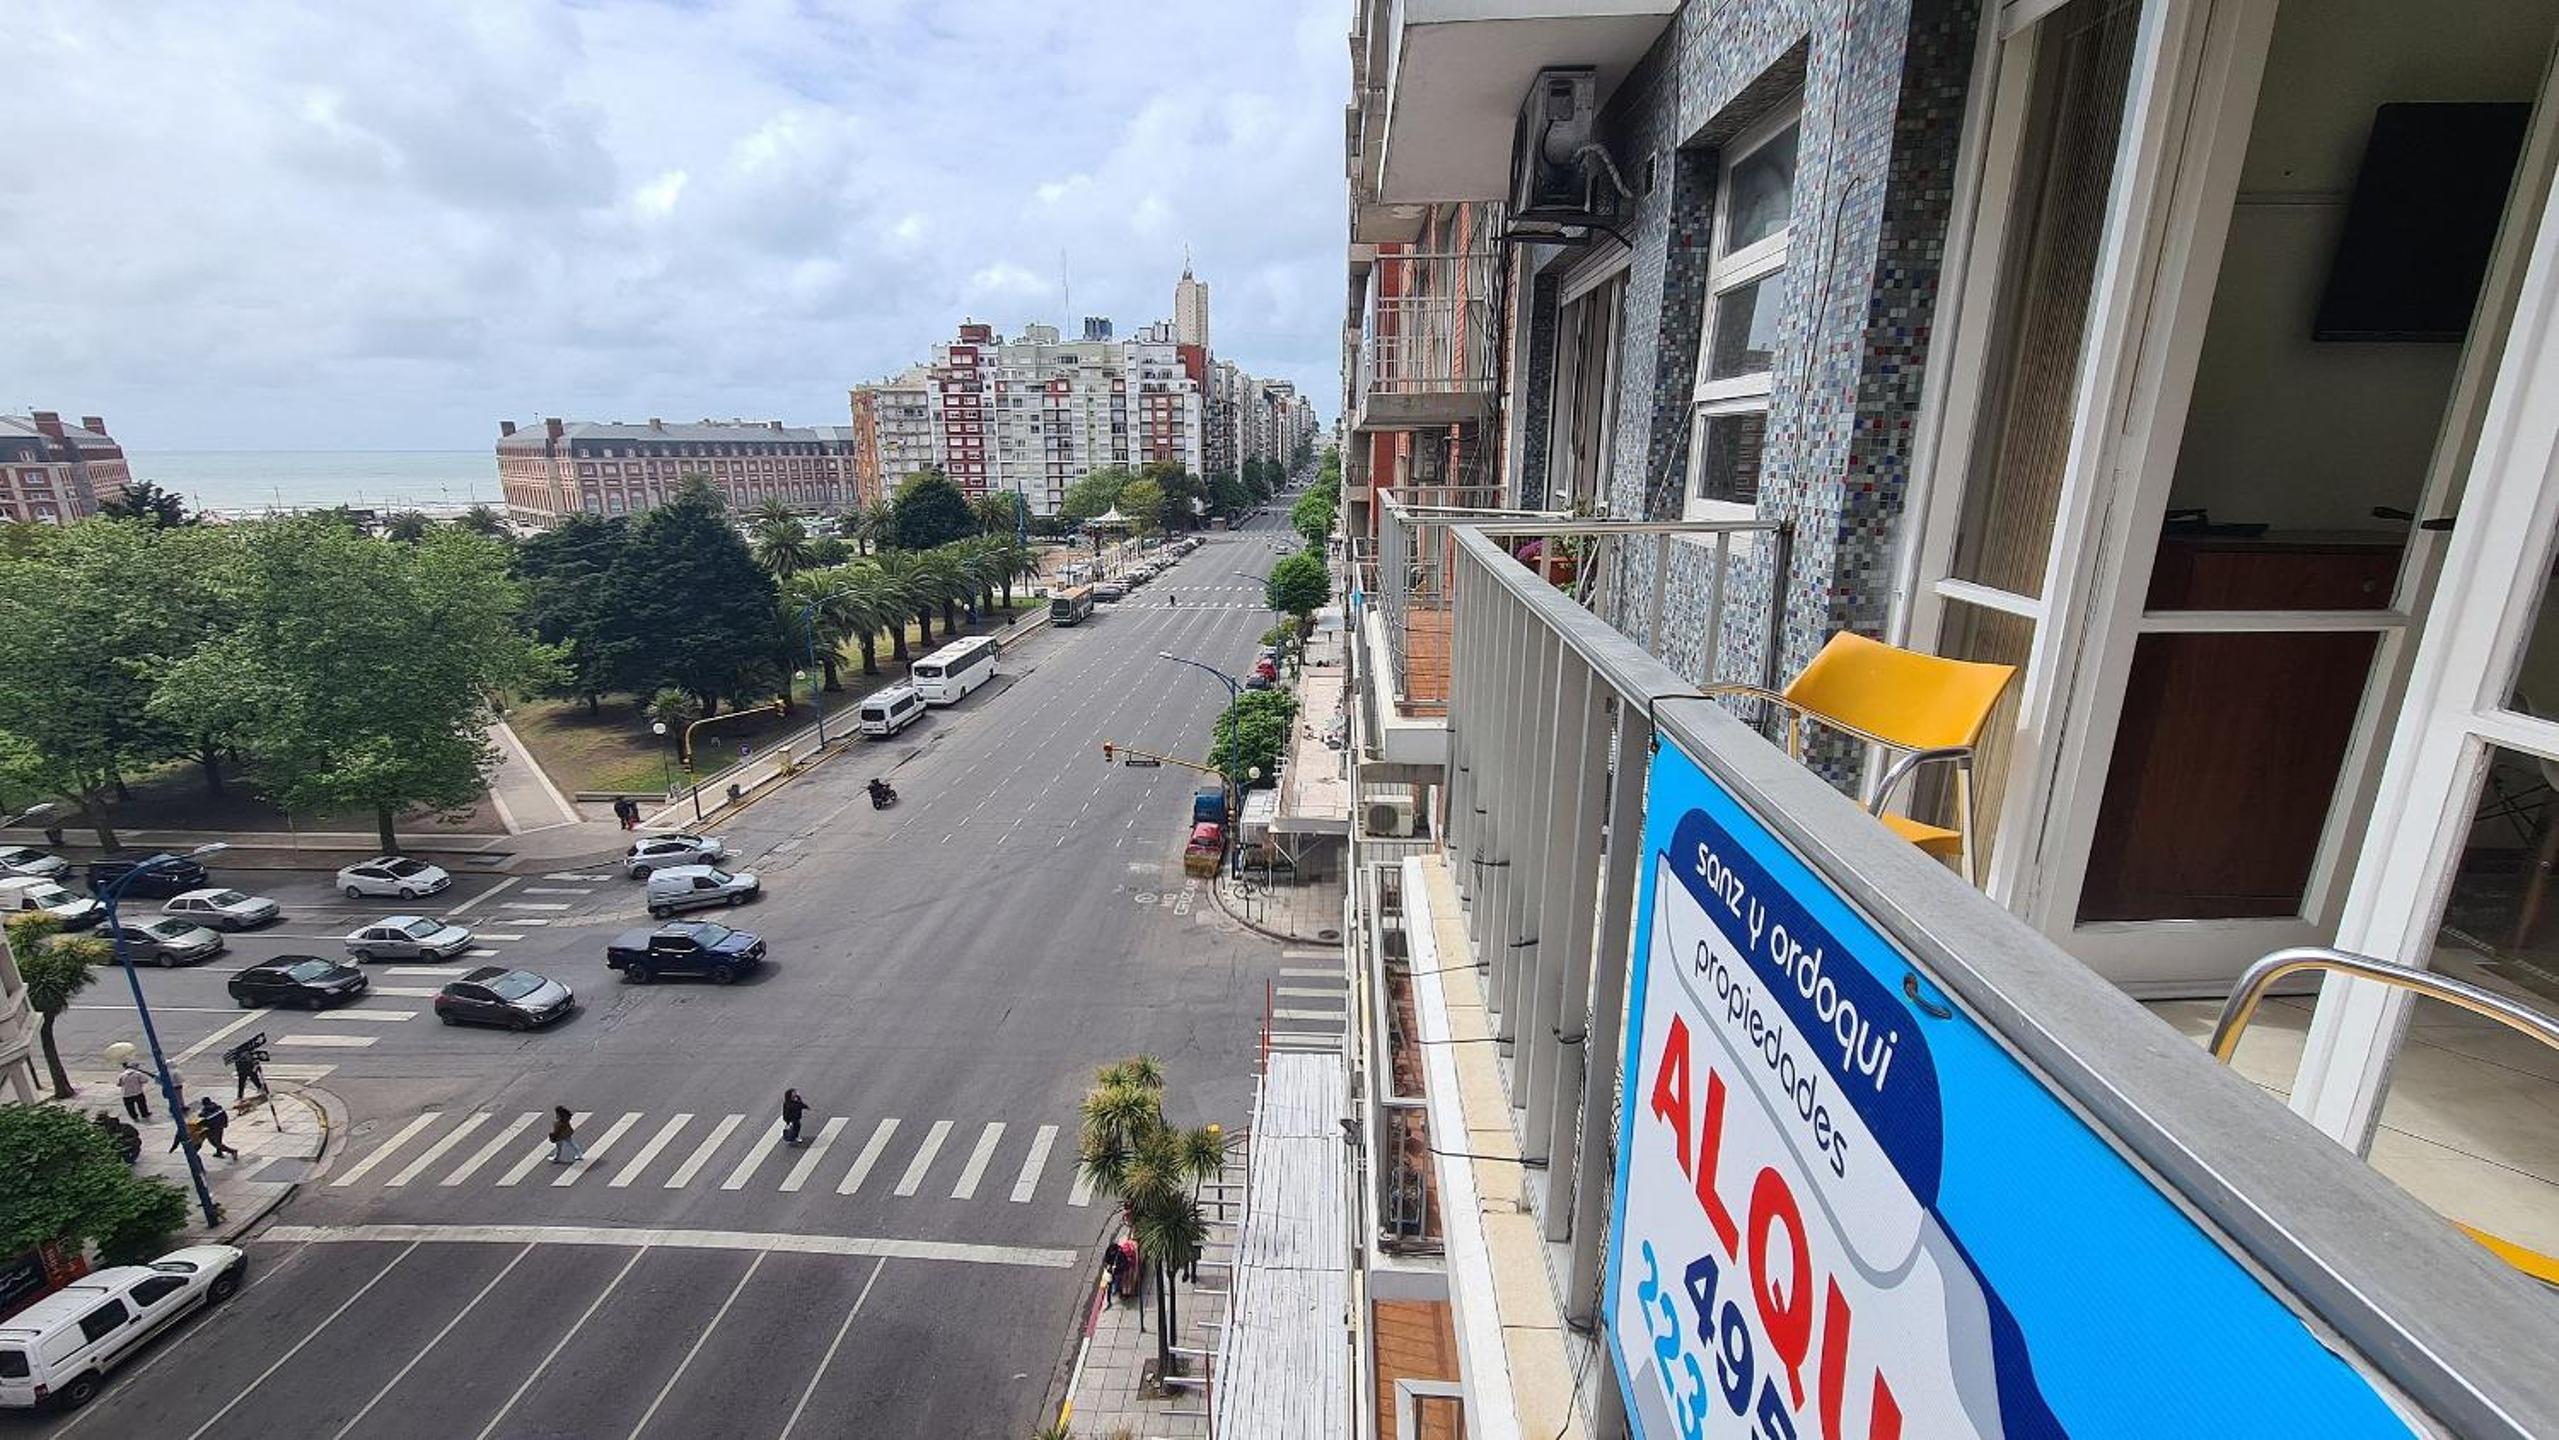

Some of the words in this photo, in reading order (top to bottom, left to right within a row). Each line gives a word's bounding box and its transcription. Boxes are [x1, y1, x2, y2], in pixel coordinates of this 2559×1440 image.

[1694, 938, 1848, 1180] propiedades
[1695, 842, 1745, 919] sanz
[1749, 896, 1765, 950] y
[1770, 924, 1898, 1093] ordoqui
